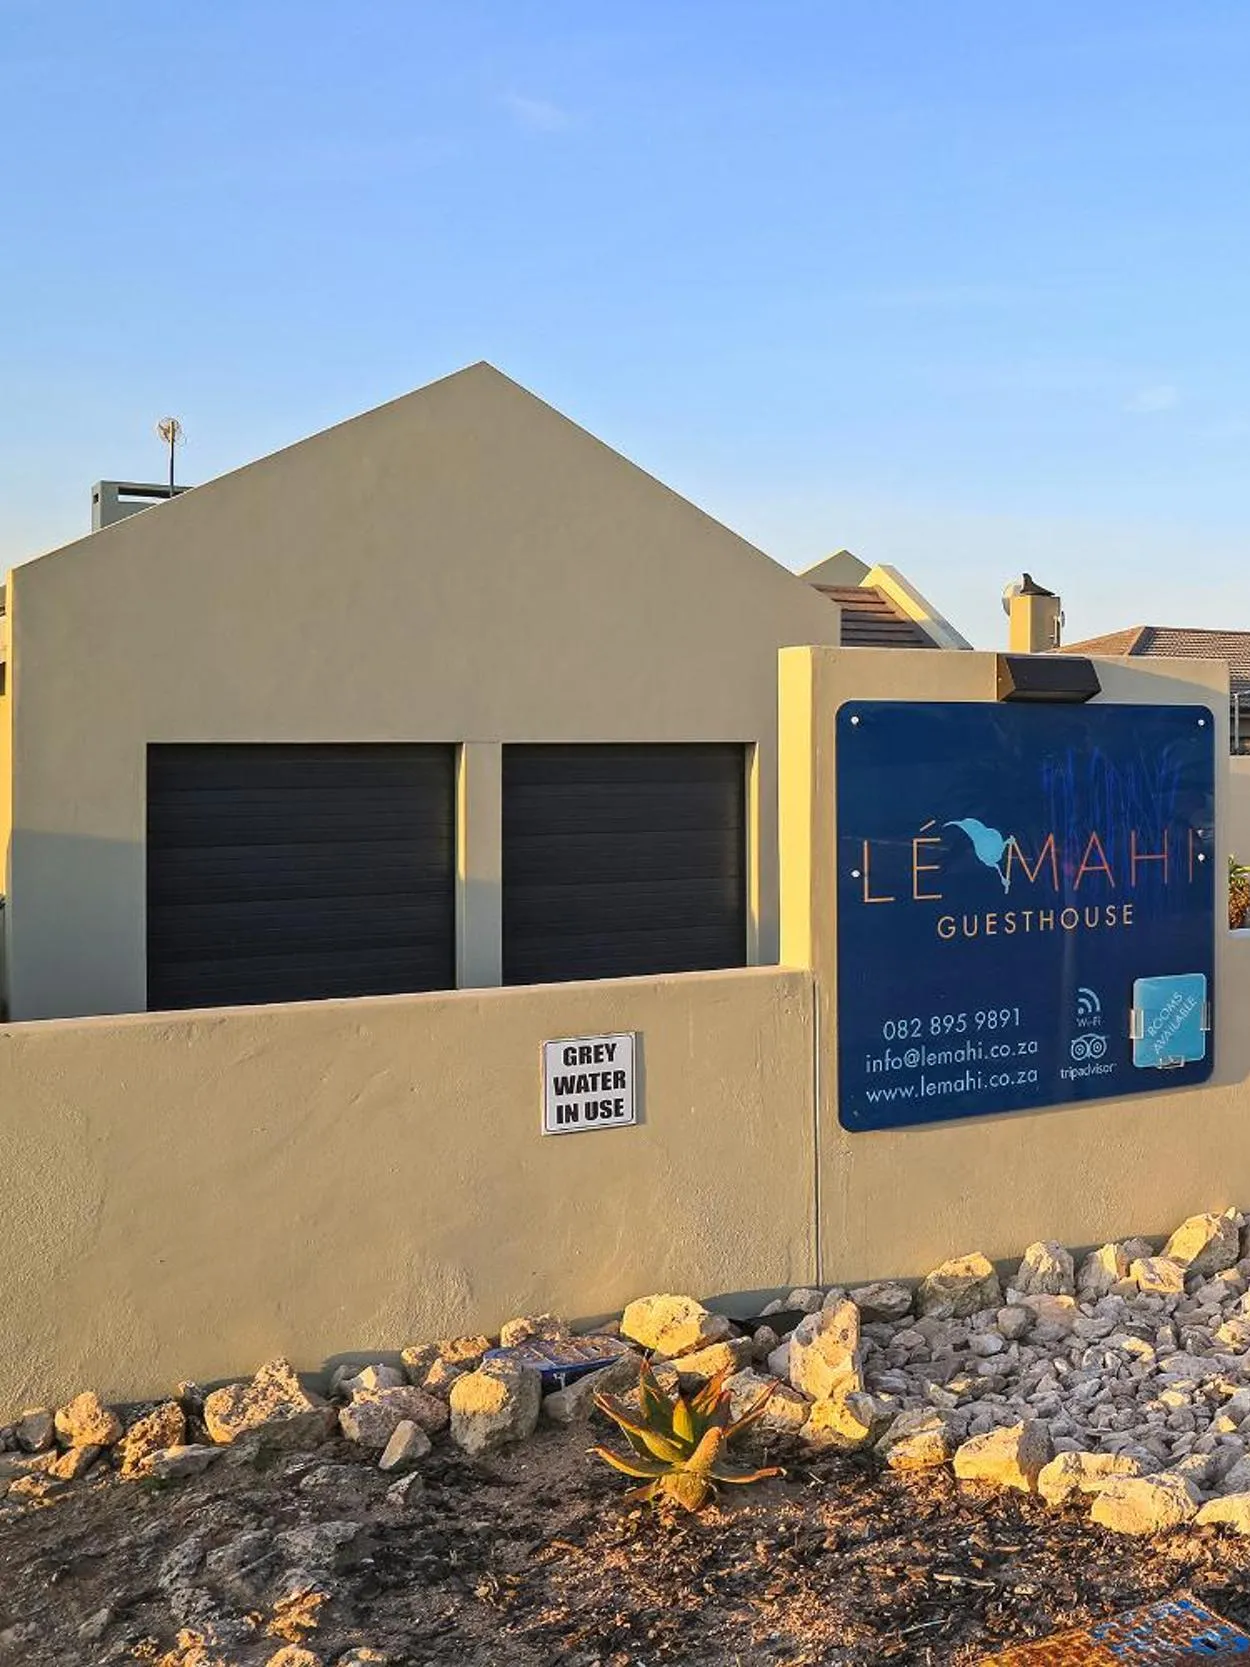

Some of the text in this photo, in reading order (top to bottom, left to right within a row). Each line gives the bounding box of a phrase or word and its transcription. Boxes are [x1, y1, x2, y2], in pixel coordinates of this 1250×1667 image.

[1005, 828, 1194, 892] MAHI
[937, 903, 1134, 939] GUESTHOUSE
[883, 1007, 1020, 1041] 082 895 9891
[1147, 991, 1183, 1037] ROOMS
[1153, 996, 1198, 1054] AVAILABLE
[562, 1043, 617, 1067] GREY
[865, 1039, 1038, 1073] info@lemahi.co.za
[1060, 1063, 1114, 1081] tripadvisor
[552, 1070, 626, 1096] WATER
[865, 1069, 1038, 1103] www.lemahi.co.za
[556, 1098, 625, 1124] IN USE
